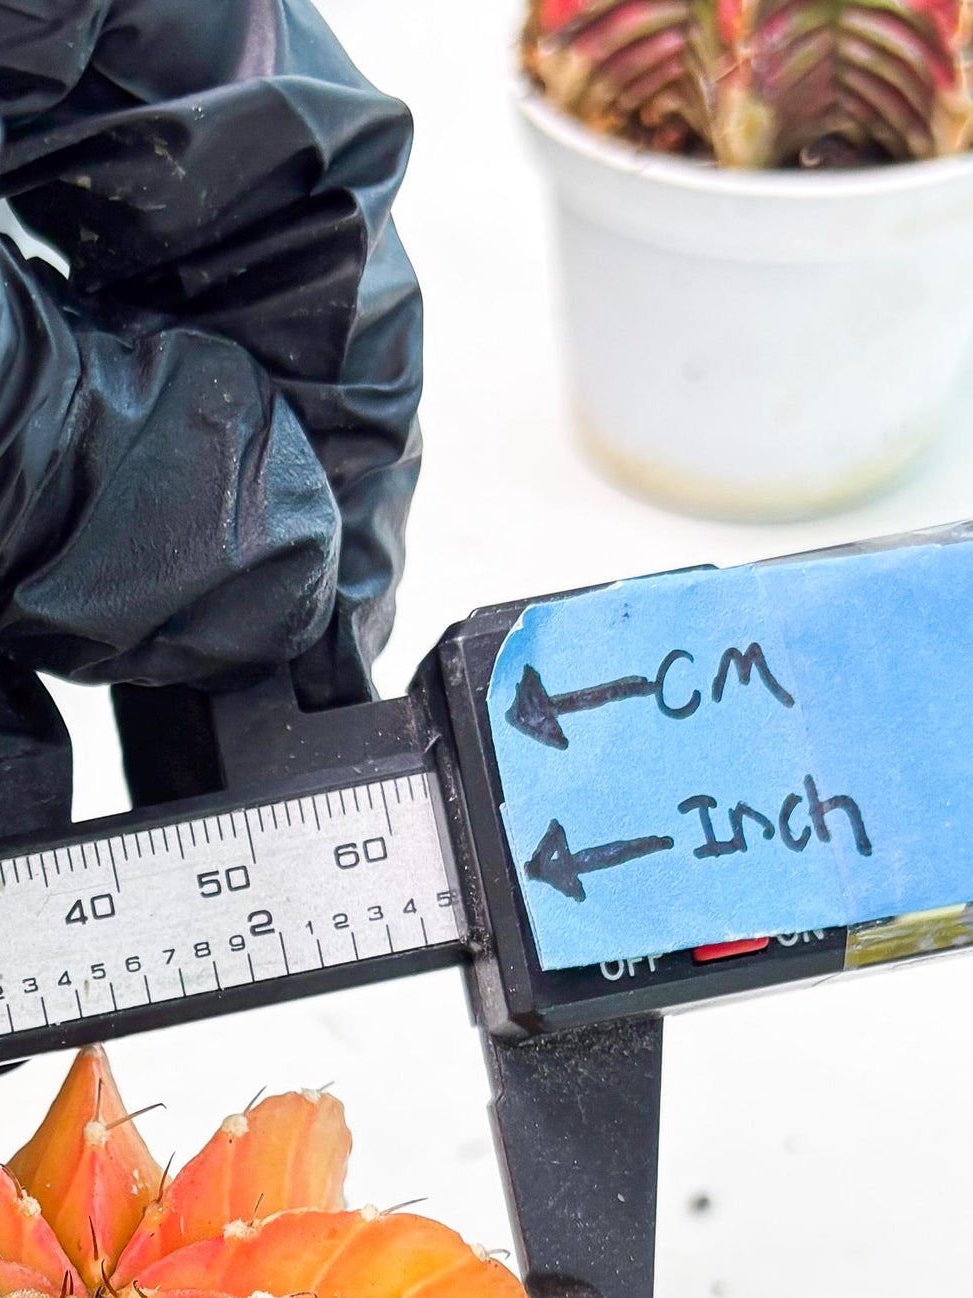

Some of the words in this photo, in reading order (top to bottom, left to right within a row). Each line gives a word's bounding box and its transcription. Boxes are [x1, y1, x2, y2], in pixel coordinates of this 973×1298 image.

[677, 774, 873, 858] Inch
[65, 893, 116, 925] 40
[196, 865, 251, 898] 50
[334, 836, 388, 869] 60
[22, 977, 39, 994] 3
[57, 970, 72, 986] 4
[90, 963, 106, 980] 5
[125, 955, 142, 973] 6
[162, 948, 176, 965] 7
[193, 941, 212, 959] 8
[228, 934, 246, 952] 9
[247, 909, 275, 937] 2
[332, 912, 350, 930] 2
[367, 905, 384, 922] 3
[402, 898, 417, 914] 4
[436, 890, 455, 907] 5
